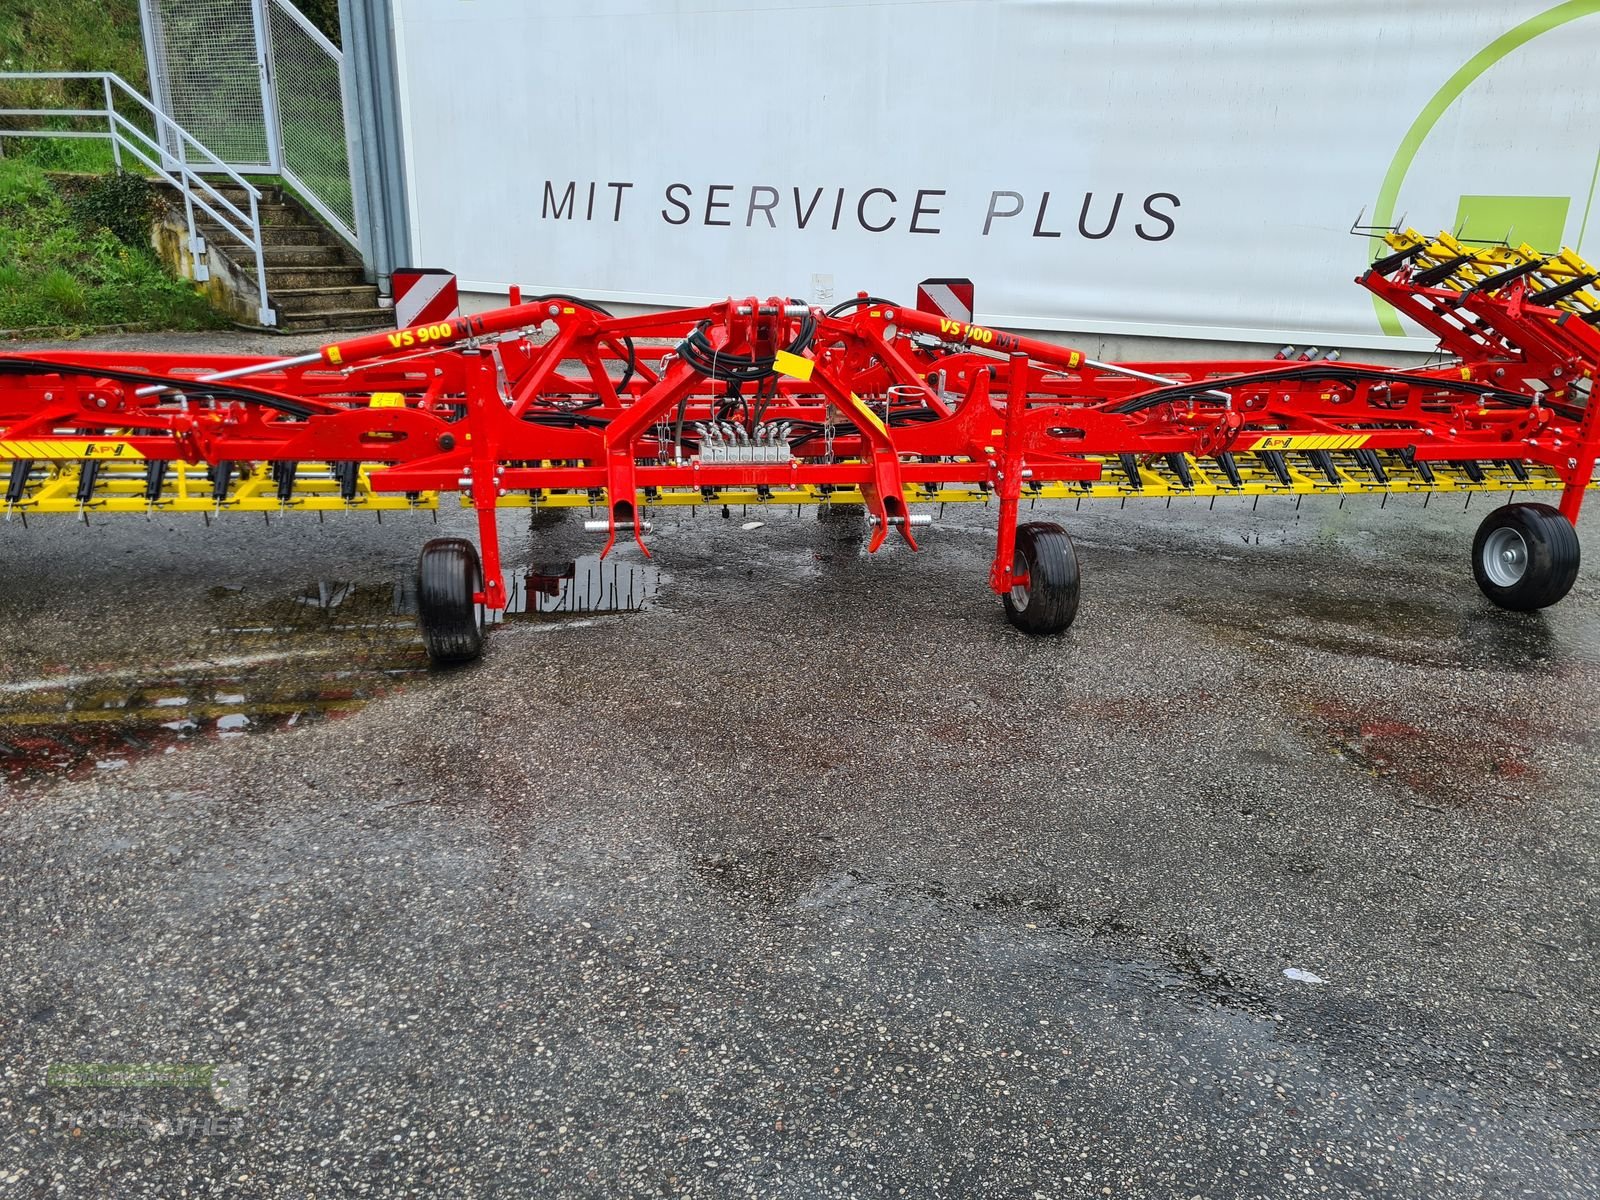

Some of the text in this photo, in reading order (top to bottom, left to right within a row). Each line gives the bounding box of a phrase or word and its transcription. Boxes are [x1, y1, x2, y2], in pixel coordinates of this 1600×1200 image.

[542, 180, 1181, 241] MIT SERVICE PLUS
[387, 331, 414, 348] VS
[417, 323, 452, 343] 900
[940, 318, 1019, 350] VS 900 M1
